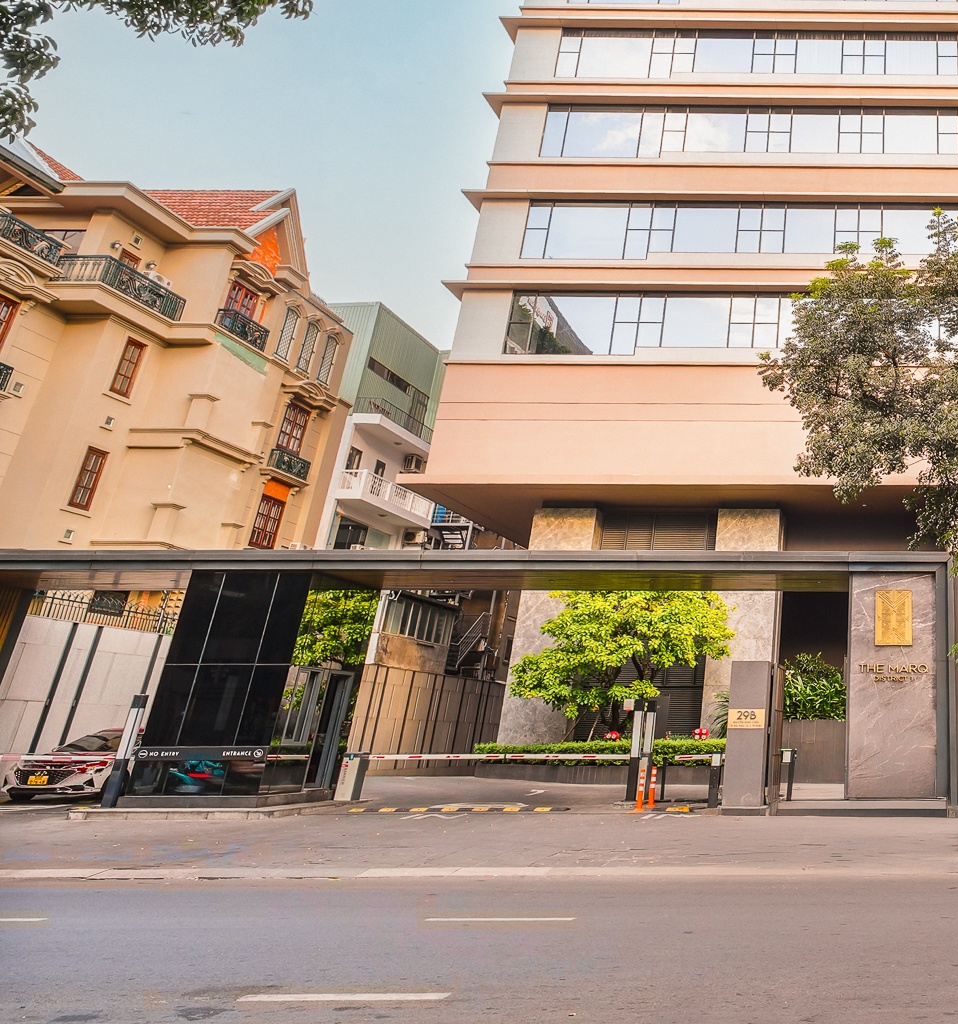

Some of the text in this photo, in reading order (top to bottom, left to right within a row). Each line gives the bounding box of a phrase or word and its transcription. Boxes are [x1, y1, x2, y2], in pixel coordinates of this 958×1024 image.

[859, 663, 929, 674] THE MARQ
[873, 675, 909, 683] DISTRICT
